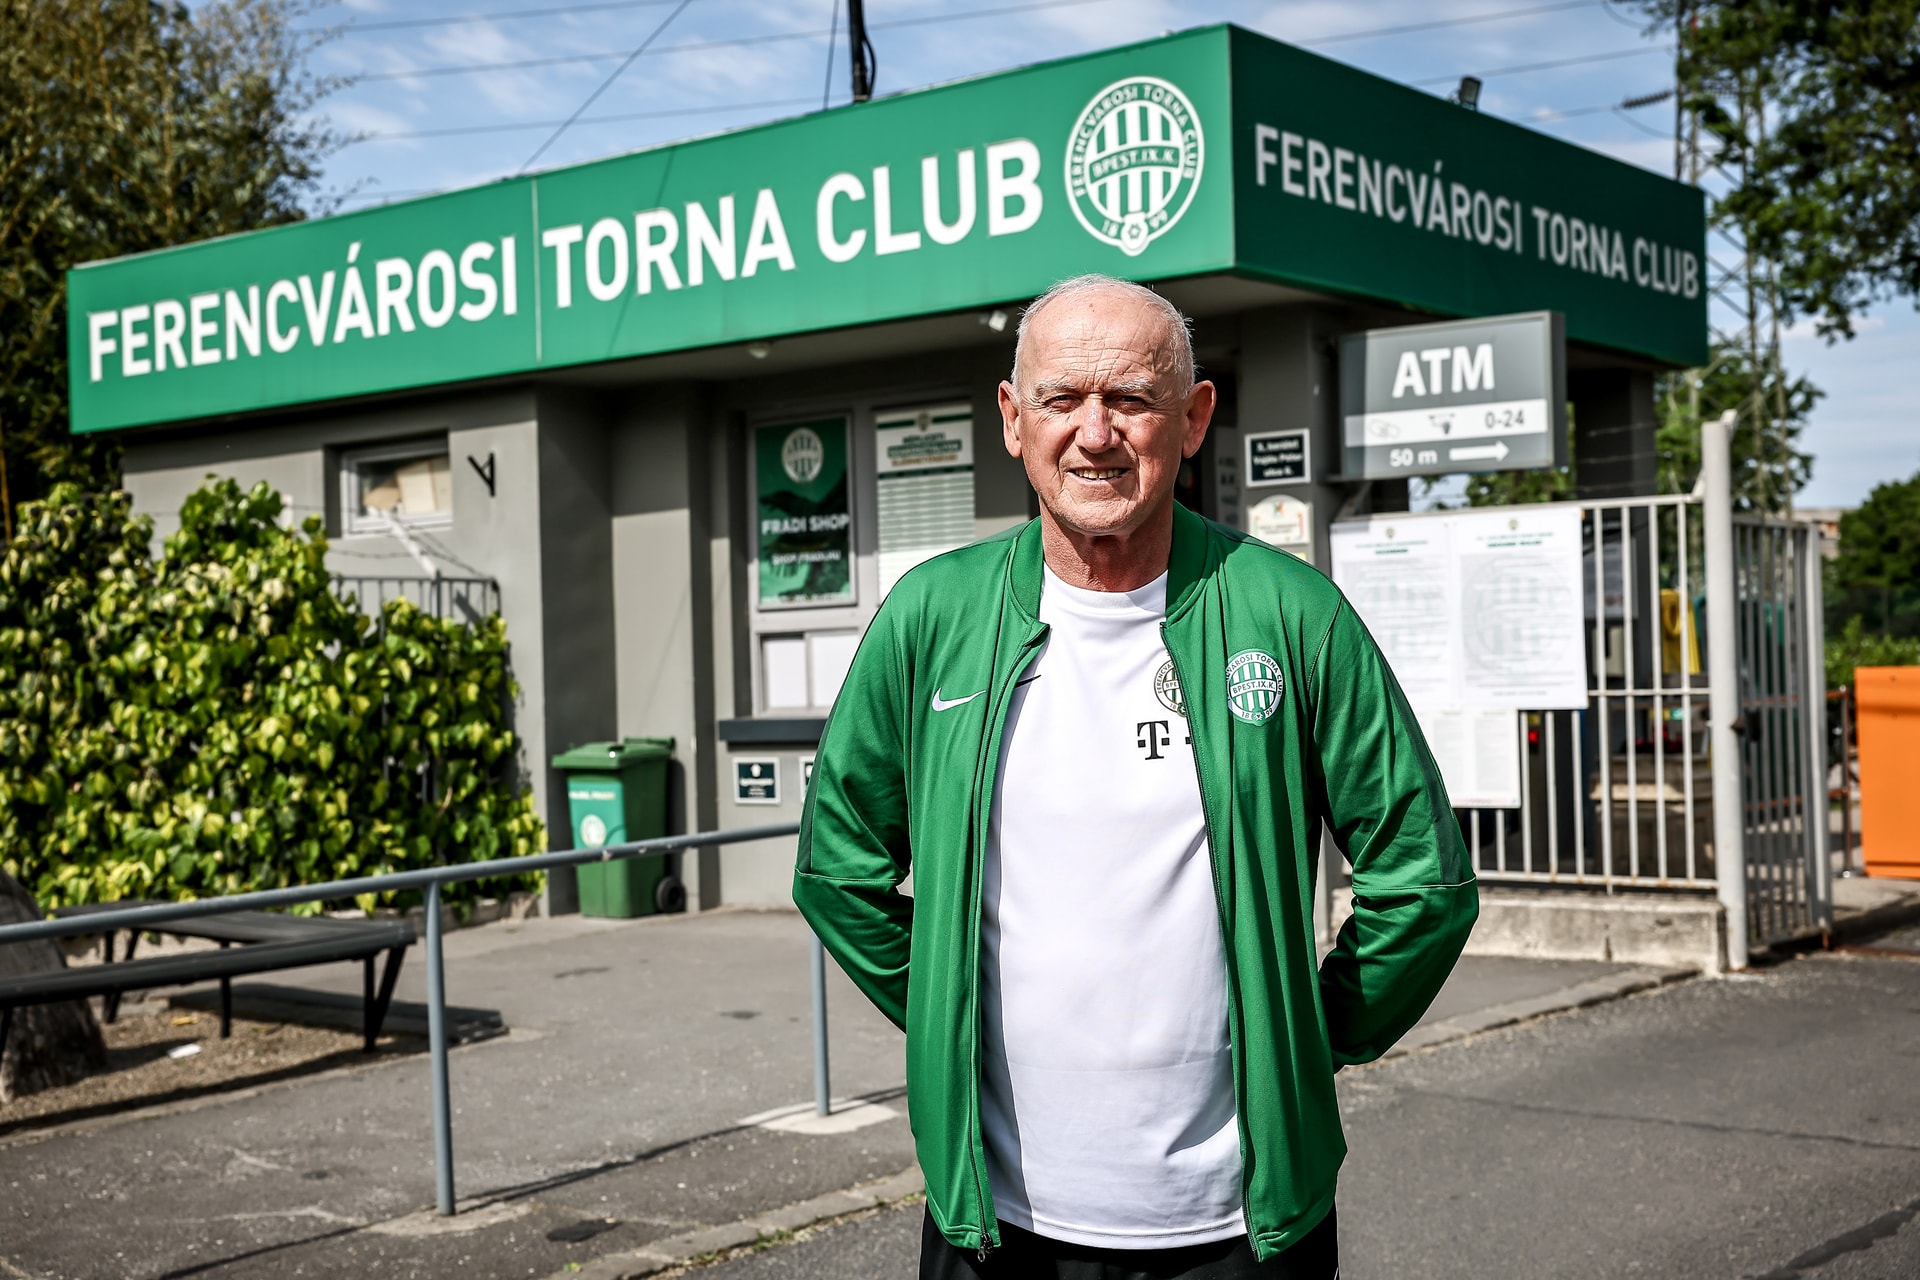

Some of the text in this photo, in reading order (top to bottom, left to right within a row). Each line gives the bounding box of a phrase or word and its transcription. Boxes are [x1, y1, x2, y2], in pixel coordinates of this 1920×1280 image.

[1143, 85, 1189, 128] TORNA
[1255, 123, 1699, 300] FERENCVÁROSI TORNA CLUB
[88, 138, 1044, 383] FERENCVÁROSI TORNA CLUB
[1392, 343, 1495, 398] ATM
[1485, 409, 1525, 429] 0-24
[1389, 448, 1438, 467] 50 m
[761, 513, 849, 536] FRADI SHOP
[1255, 654, 1279, 673] TORNA
